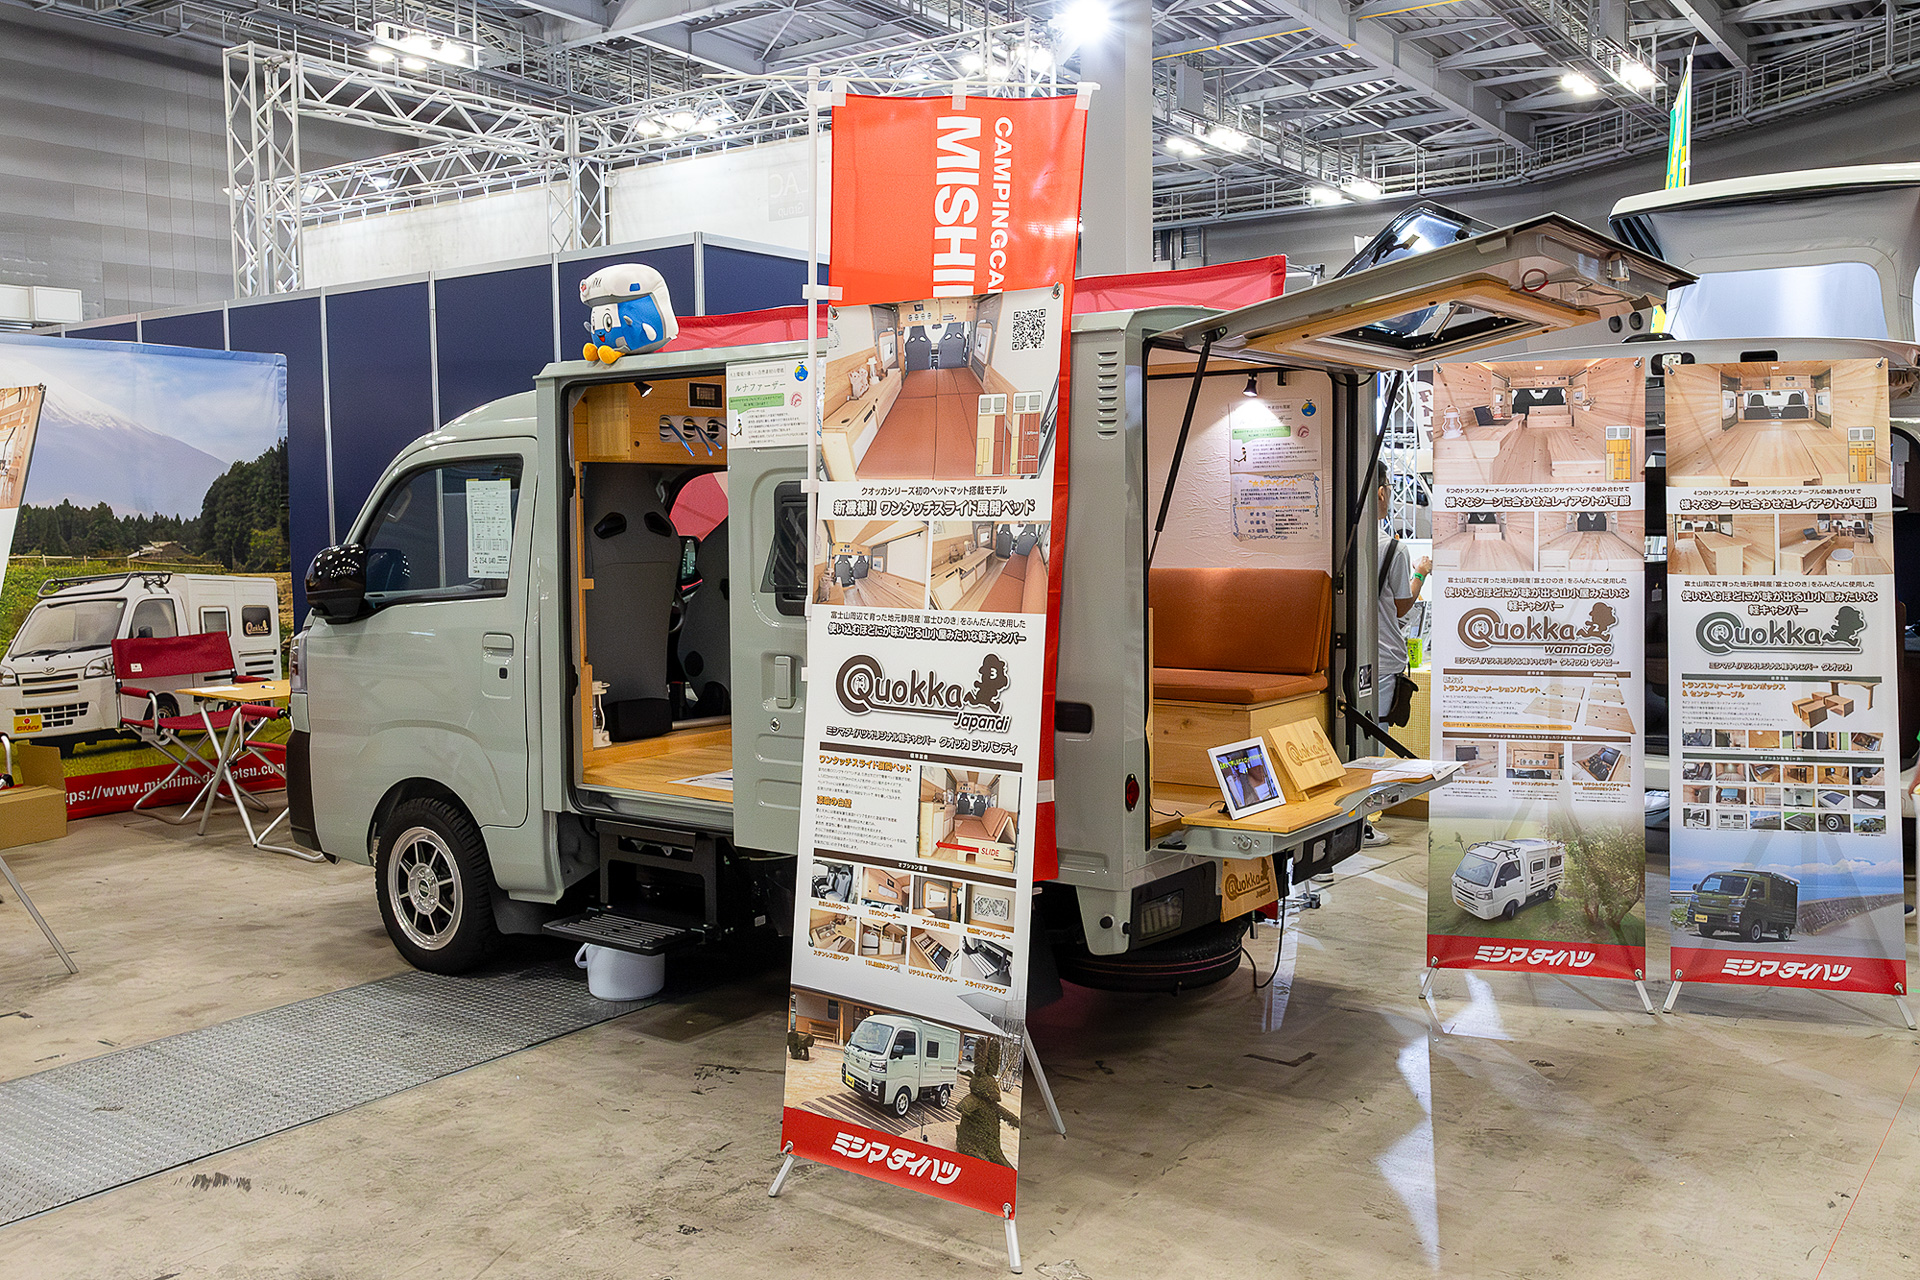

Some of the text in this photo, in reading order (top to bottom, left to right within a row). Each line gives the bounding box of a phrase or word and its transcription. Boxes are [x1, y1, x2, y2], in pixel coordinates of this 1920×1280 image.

[988, 116, 1013, 294] CAMPINGCA
[735, 381, 786, 393] ルナファーザー
[1444, 495, 1632, 508] 様々なシーンに合わせたレイアウトが可能
[1680, 497, 1877, 510] 様々なシーンに合わせたレイアウトが可能
[1458, 608, 1575, 650] Quokka
[1696, 612, 1821, 655] Quokka
[1545, 645, 1612, 655] wannabee
[836, 654, 964, 714] Quokka
[955, 713, 1011, 732] Japandi
[981, 847, 1000, 857] SLIDE
[1225, 872, 1262, 902] Quokka
[1474, 945, 1594, 968] ミシマダイハツ
[1721, 957, 1852, 982] ミシマダイハツ
[831, 1132, 962, 1185] ミシマダイハツ
